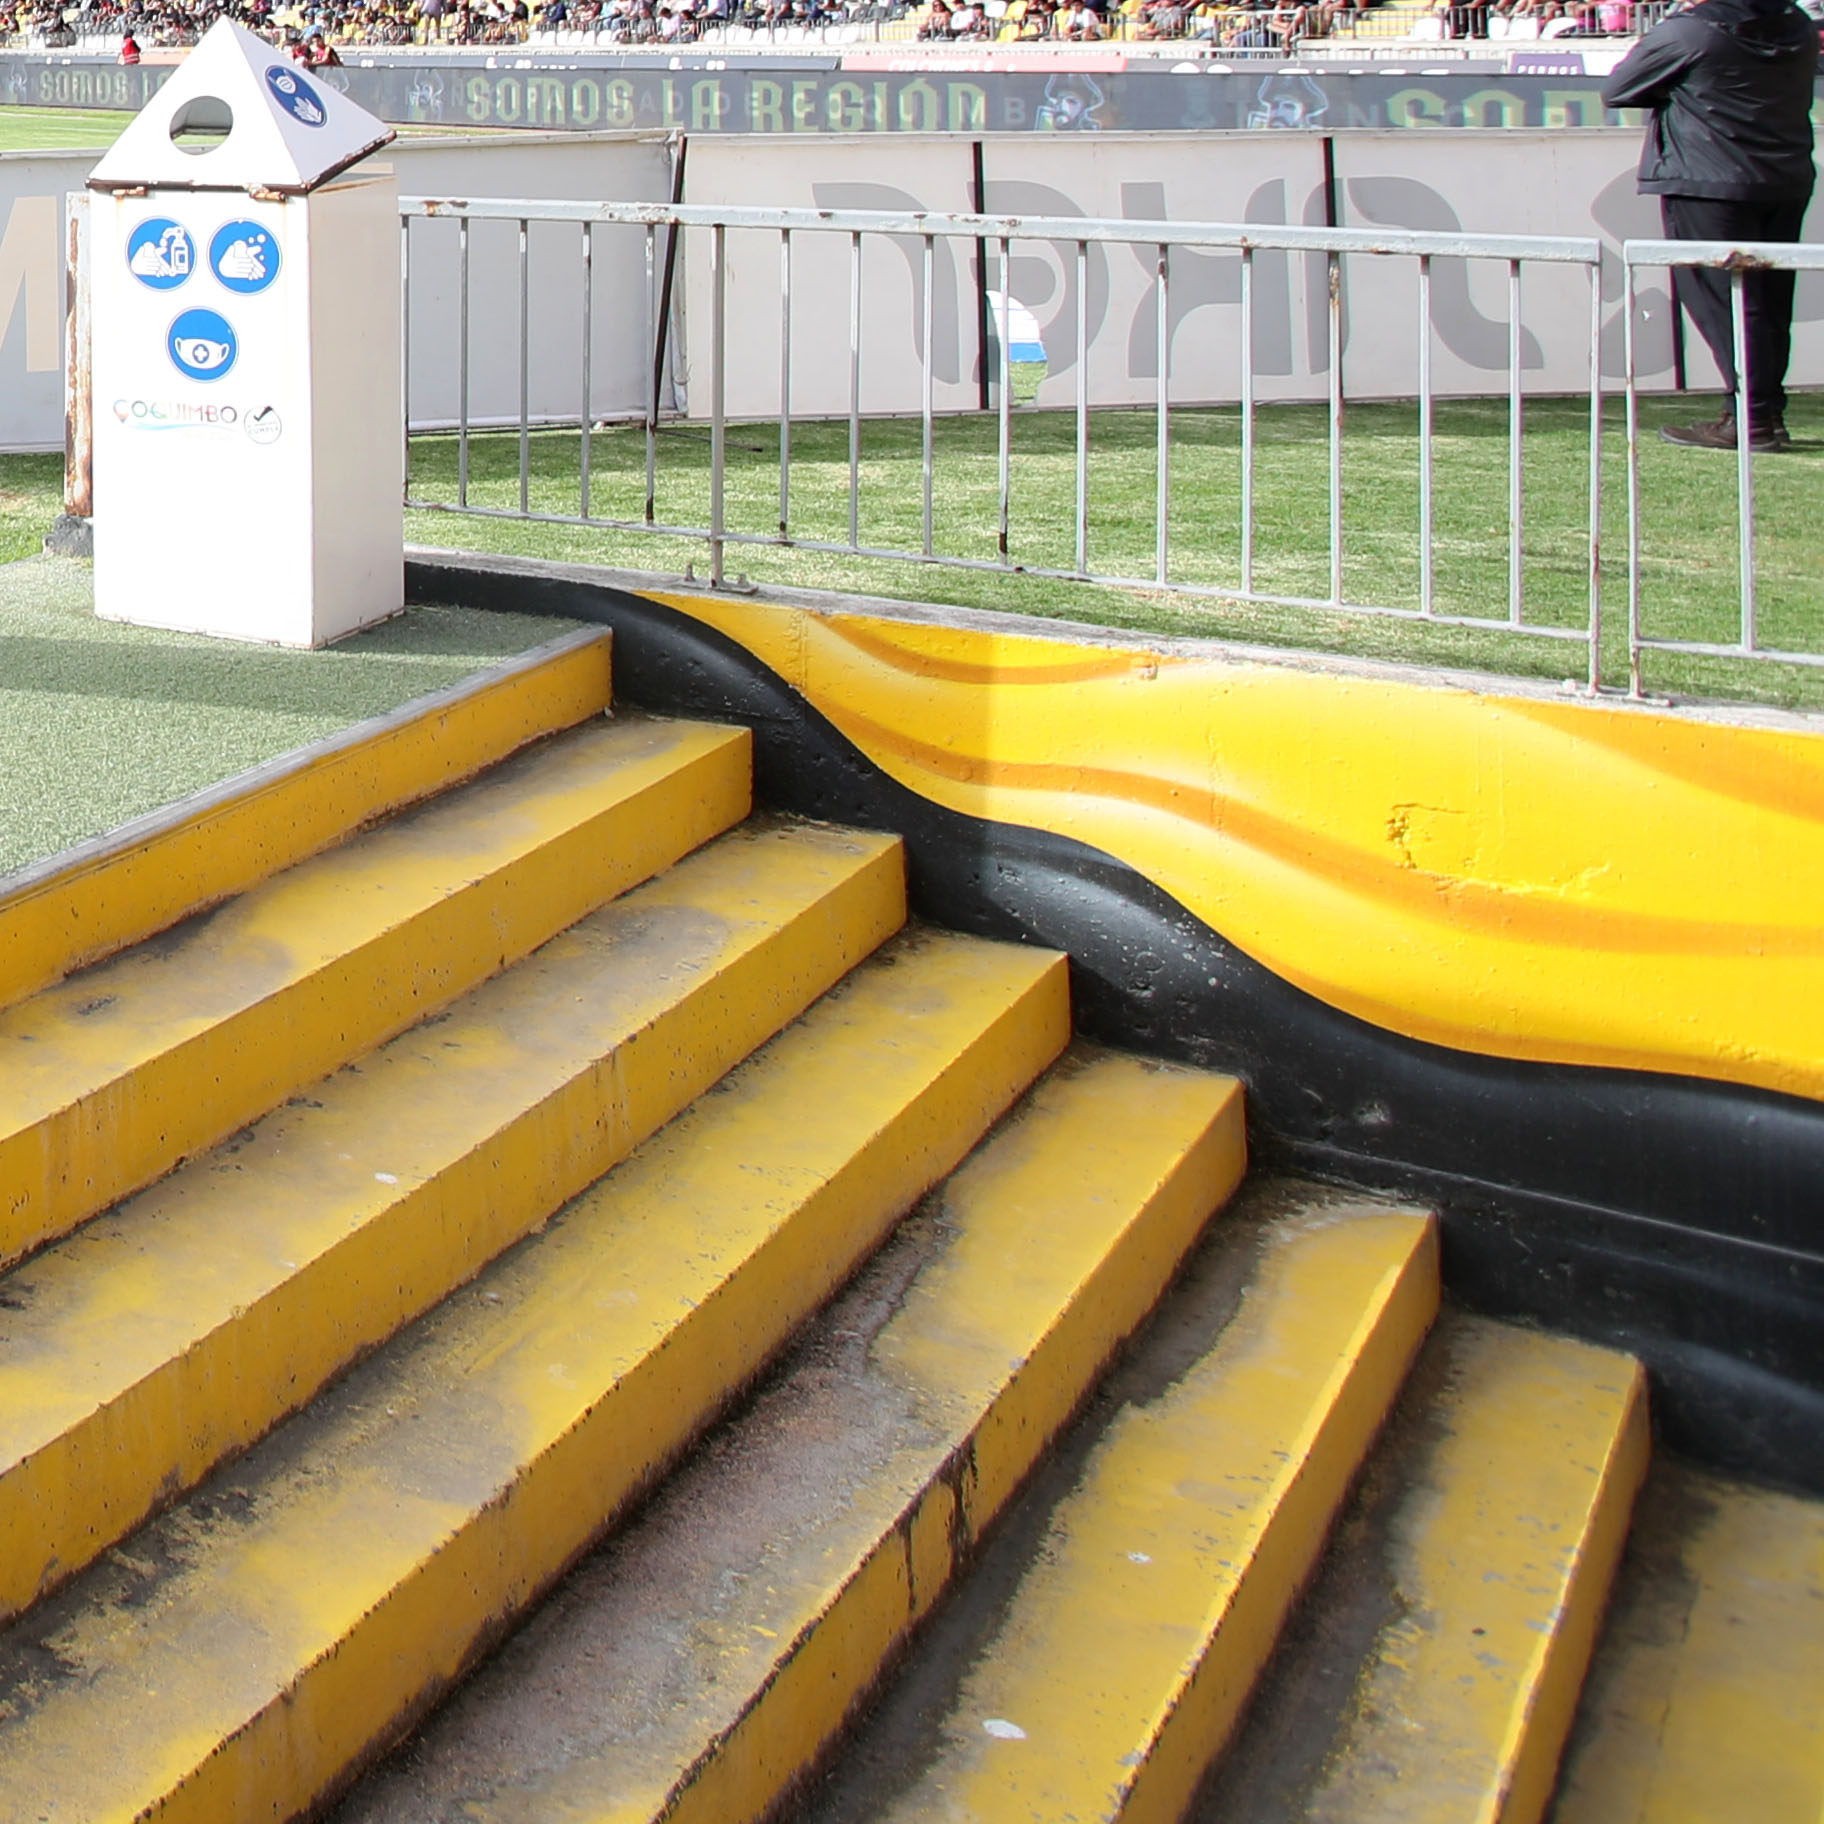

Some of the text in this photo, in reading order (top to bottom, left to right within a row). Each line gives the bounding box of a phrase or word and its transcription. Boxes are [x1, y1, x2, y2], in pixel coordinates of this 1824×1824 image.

[40, 70, 129, 105] SOMOS
[466, 76, 634, 127] SOMOS
[663, 78, 722, 130] LA
[112, 398, 239, 425] COQUIMBO
